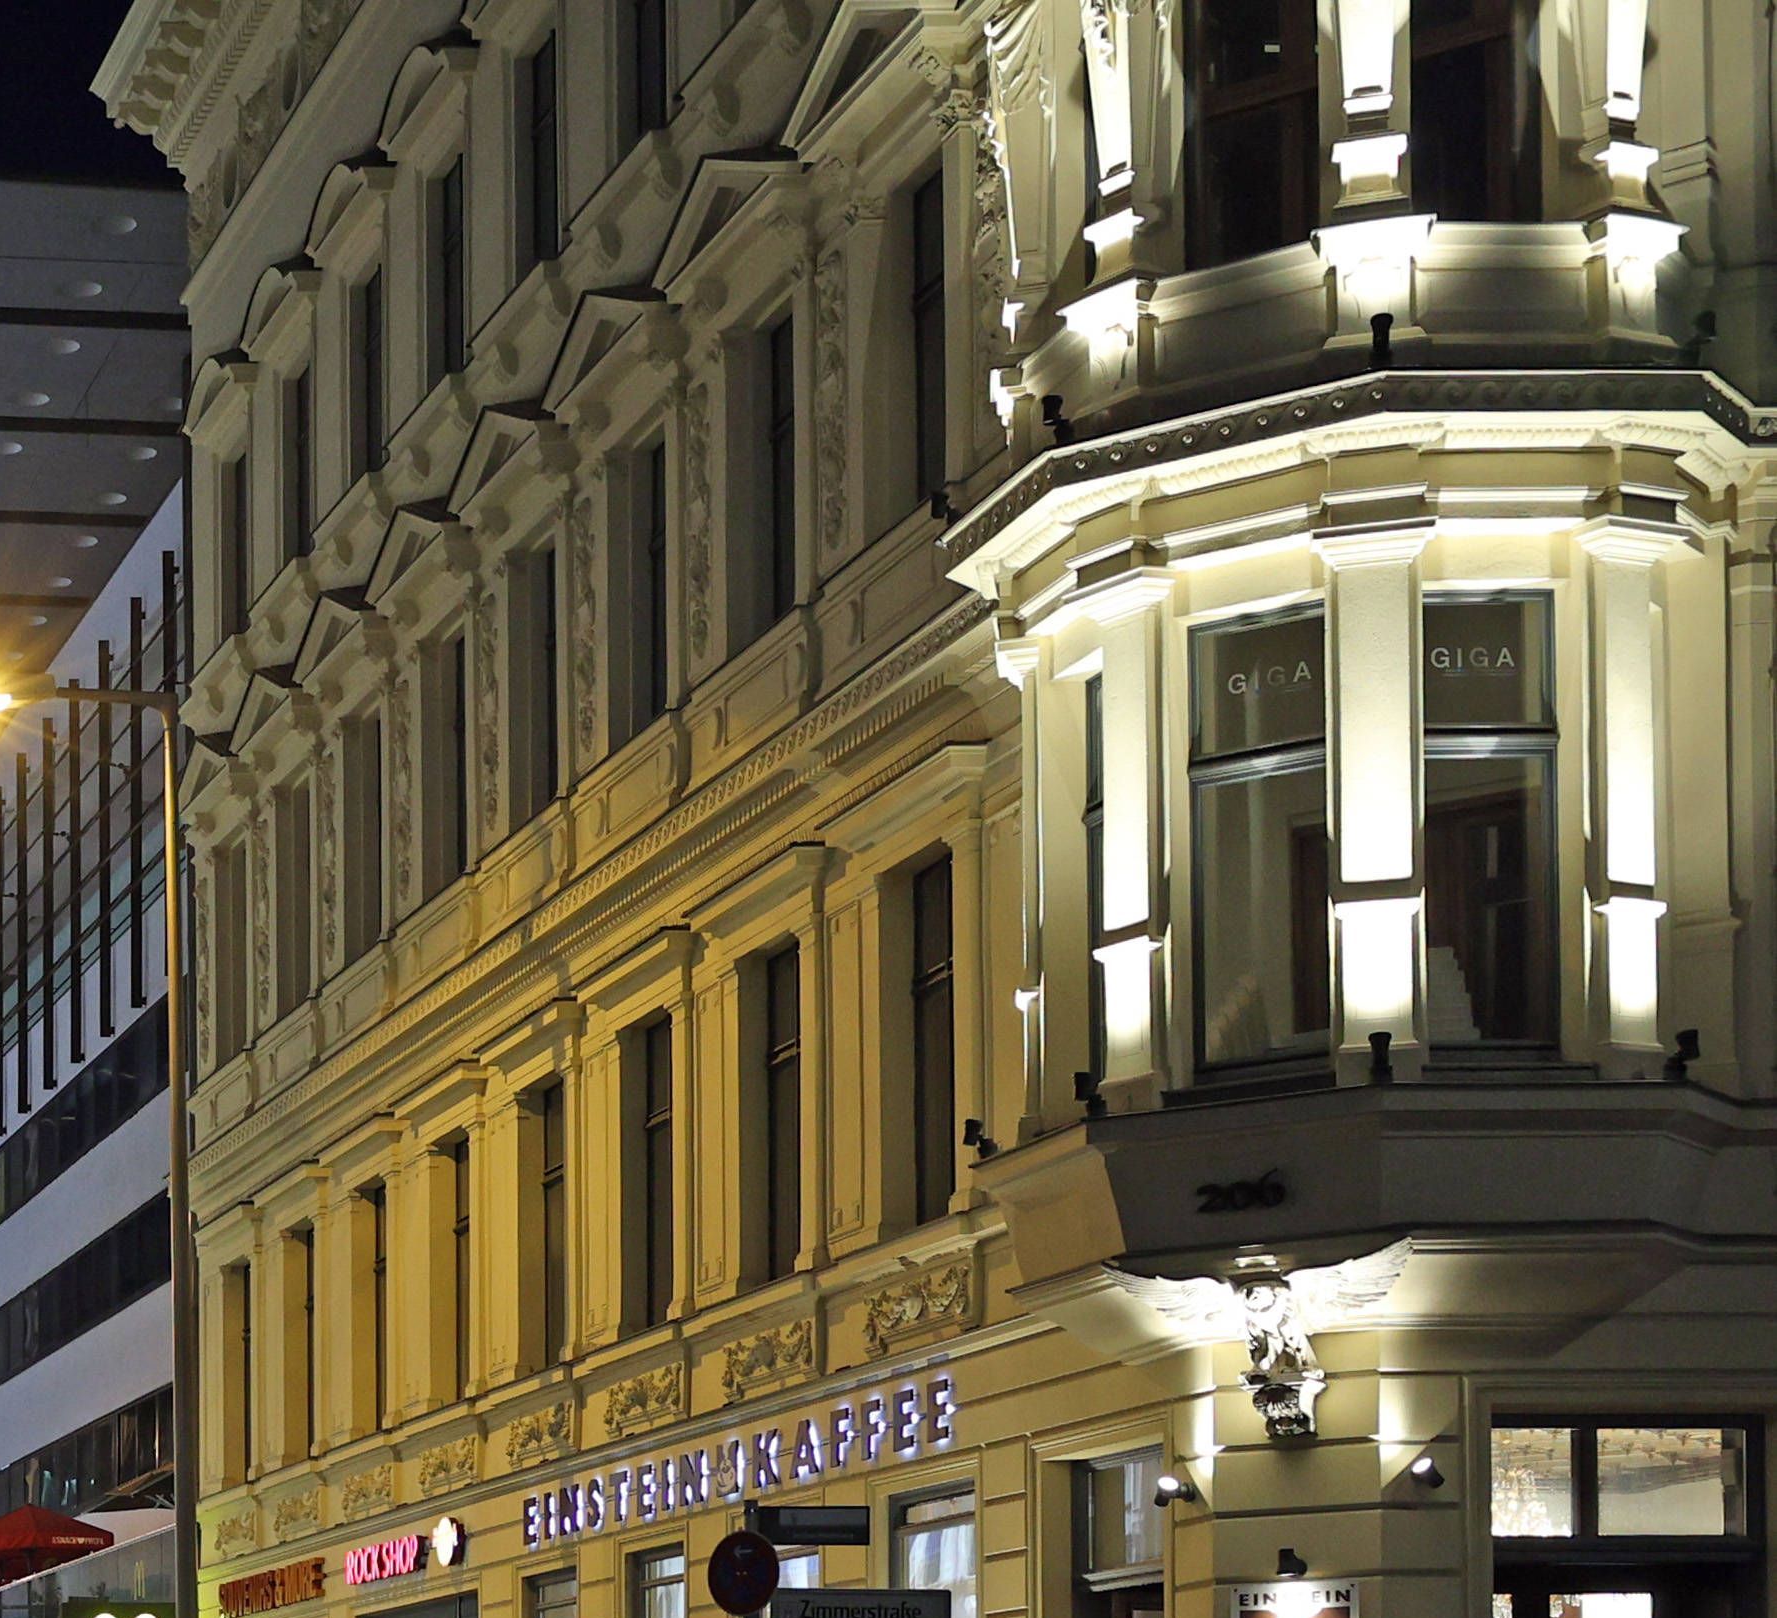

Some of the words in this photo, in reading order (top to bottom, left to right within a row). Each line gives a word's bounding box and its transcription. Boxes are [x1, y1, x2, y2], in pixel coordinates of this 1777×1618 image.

[1431, 645, 1514, 670] GIGA
[1228, 661, 1311, 695] GIGA
[1196, 1168, 1286, 1215] 206
[525, 1449, 708, 1546] EINSTEIN
[753, 1380, 952, 1488] KAFFEE
[345, 1545, 381, 1586] ROCK
[381, 1534, 420, 1580] SHOP
[1238, 1588, 1351, 1607] EINEIN
